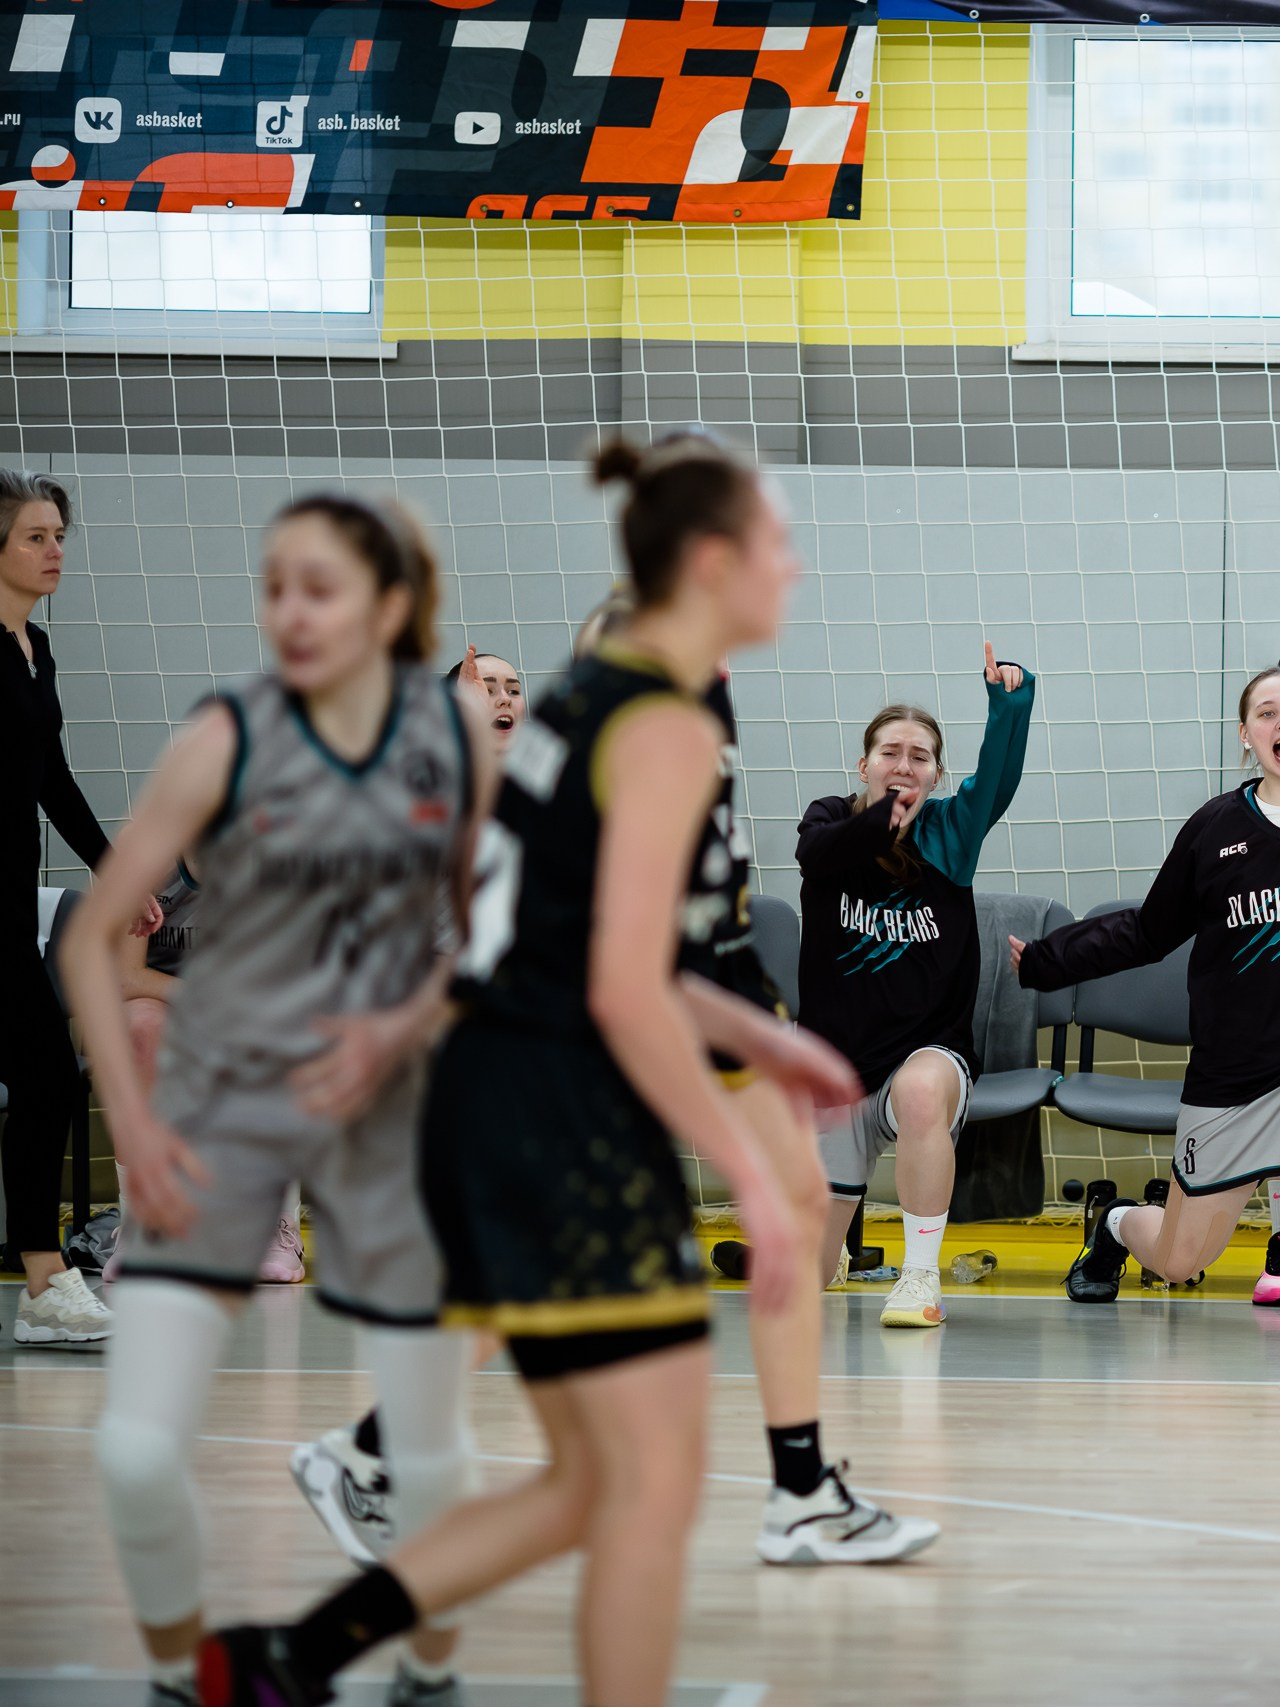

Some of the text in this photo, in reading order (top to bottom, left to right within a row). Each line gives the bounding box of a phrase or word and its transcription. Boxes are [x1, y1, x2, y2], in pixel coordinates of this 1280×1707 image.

[136, 111, 203, 128] asbasket
[515, 118, 582, 135] asbasket
[265, 136, 293, 145] TikTok
[883, 906, 940, 943] BEARS
[1184, 1138, 1196, 1174] 6
